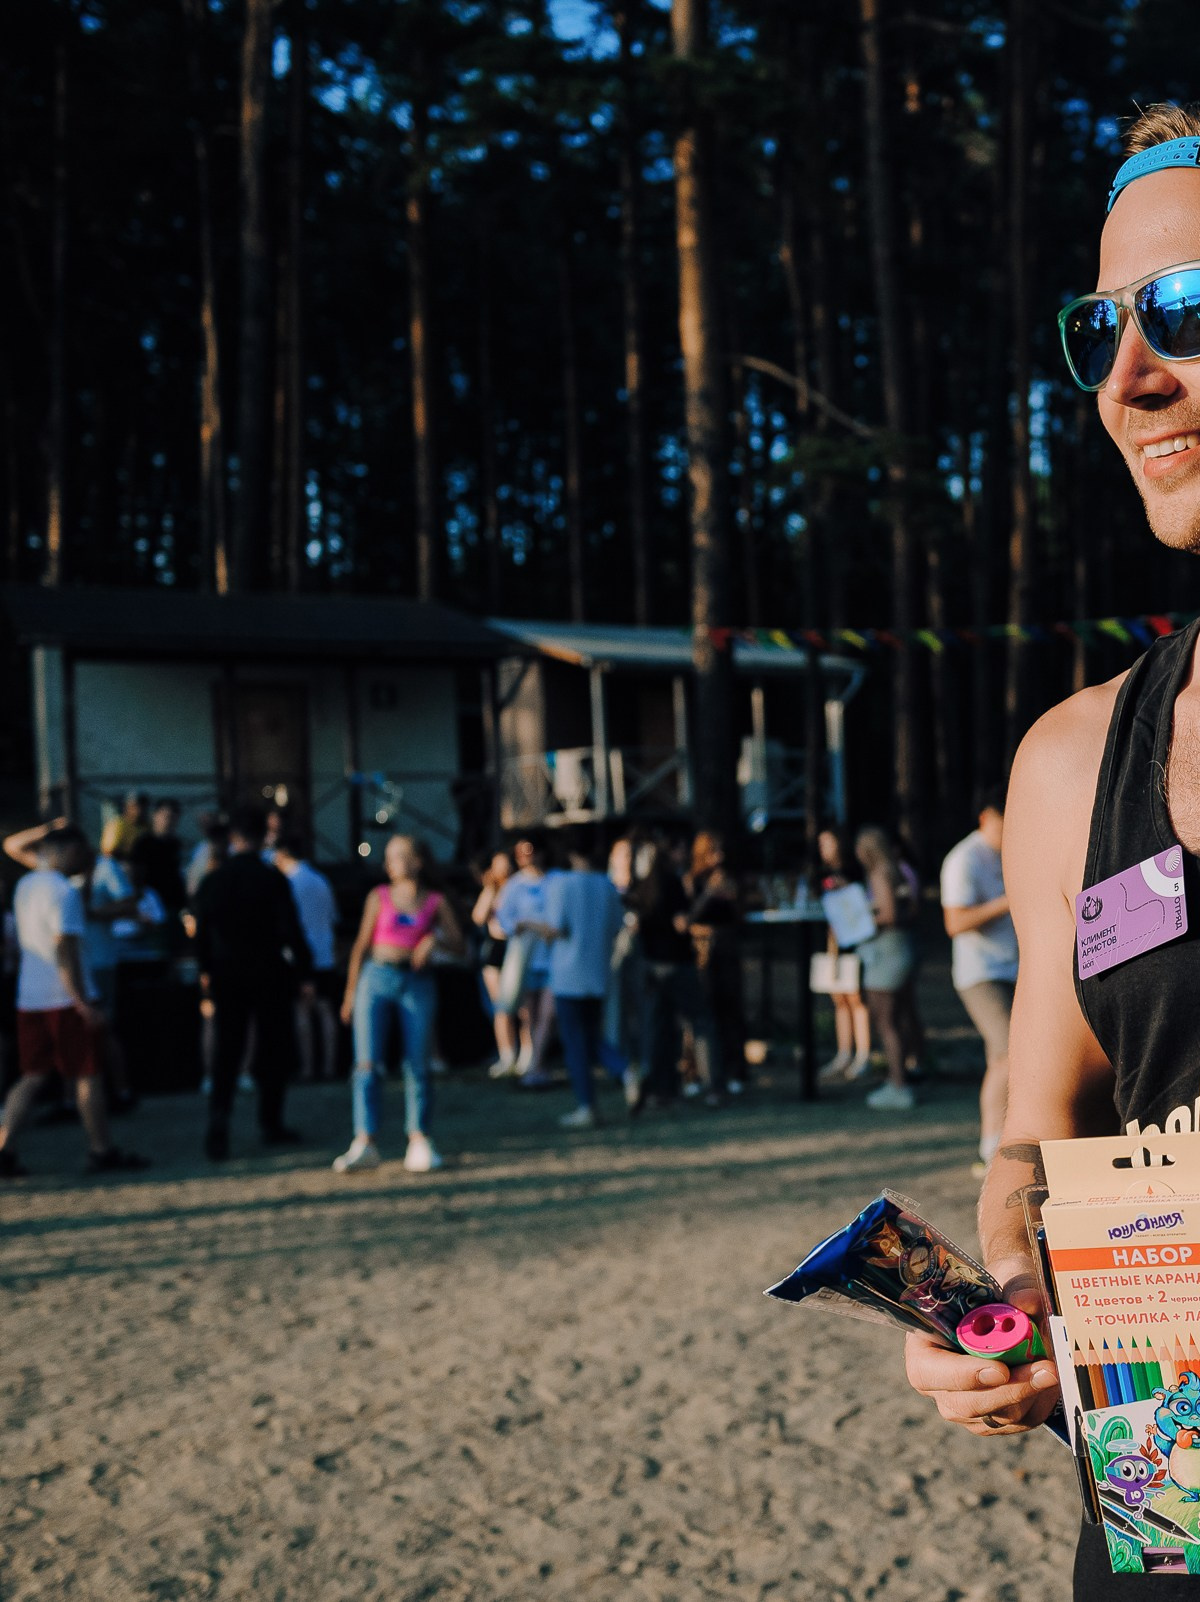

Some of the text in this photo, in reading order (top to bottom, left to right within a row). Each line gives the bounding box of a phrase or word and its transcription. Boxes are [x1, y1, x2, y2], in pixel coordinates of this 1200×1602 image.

[1174, 882, 1183, 931] 5 ОТРЯД
[1081, 924, 1117, 948] КЛИМЕНТ
[1081, 936, 1118, 958] АРИСТОВ
[1112, 1246, 1193, 1266] НАБОР
[1070, 1275, 1141, 1290] ЦВЕТНЫЕ
[1074, 1294, 1091, 1307] 12
[1094, 1296, 1143, 1307] цветов
[1147, 1294, 1155, 1302] +
[1157, 1290, 1168, 1303] 2
[1095, 1312, 1170, 1326] ТОЧИЛКА
[1173, 1313, 1181, 1321] +
